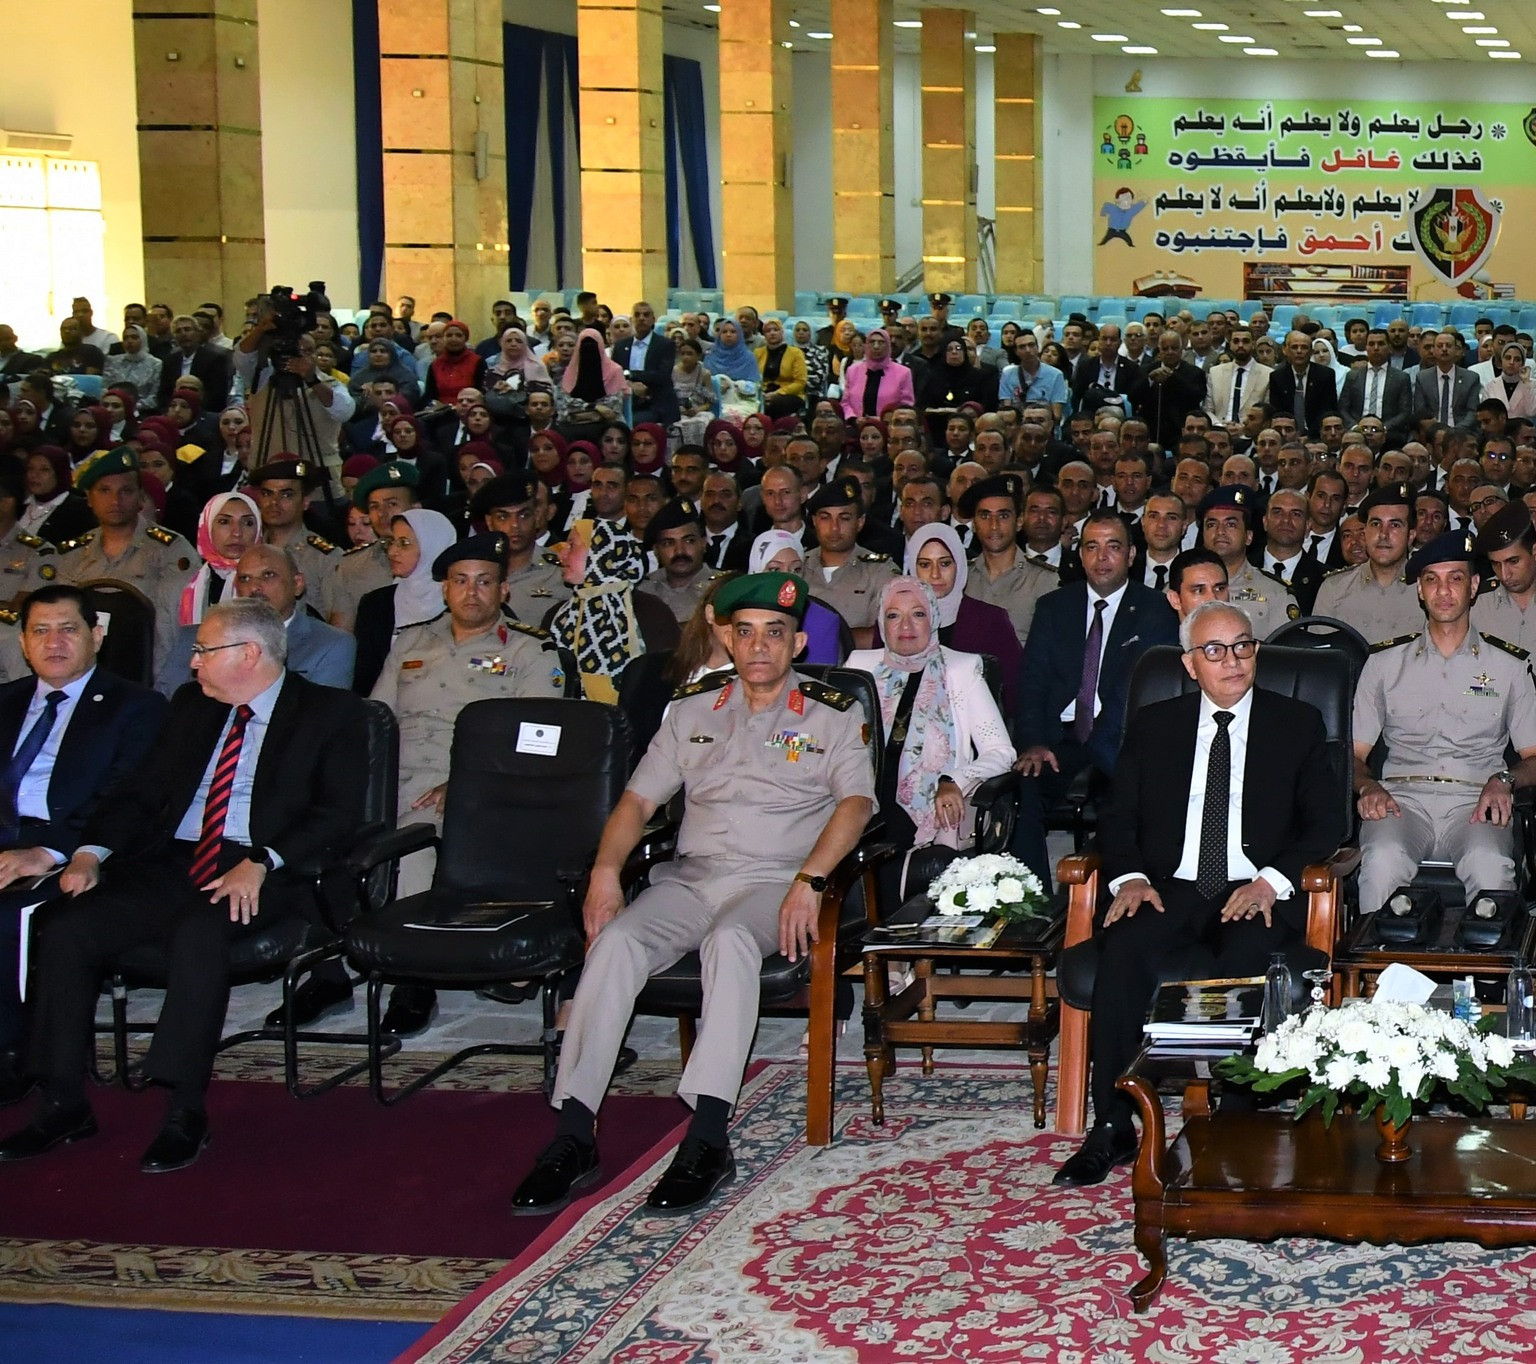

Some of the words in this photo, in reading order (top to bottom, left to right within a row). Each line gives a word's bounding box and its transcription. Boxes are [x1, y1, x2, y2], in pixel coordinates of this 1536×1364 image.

[1173, 110, 1225, 137] يعلم
[1232, 104, 1272, 133] أنه
[1280, 111, 1332, 140] يعلم
[1337, 110, 1361, 138] ولا
[1368, 113, 1420, 140] يعلم
[1427, 112, 1483, 139] رجل
[1168, 142, 1310, 171] فأيقظوه
[1320, 149, 1401, 172] غافل
[1412, 150, 1482, 171] فذلك
[1155, 187, 1204, 218] يعلم
[1210, 186, 1222, 210] لا
[1228, 180, 1267, 210] أنه
[1352, 190, 1402, 221] يعلم
[1155, 228, 1288, 257] فإجتنبوه
[1298, 224, 1382, 256] أحمق
